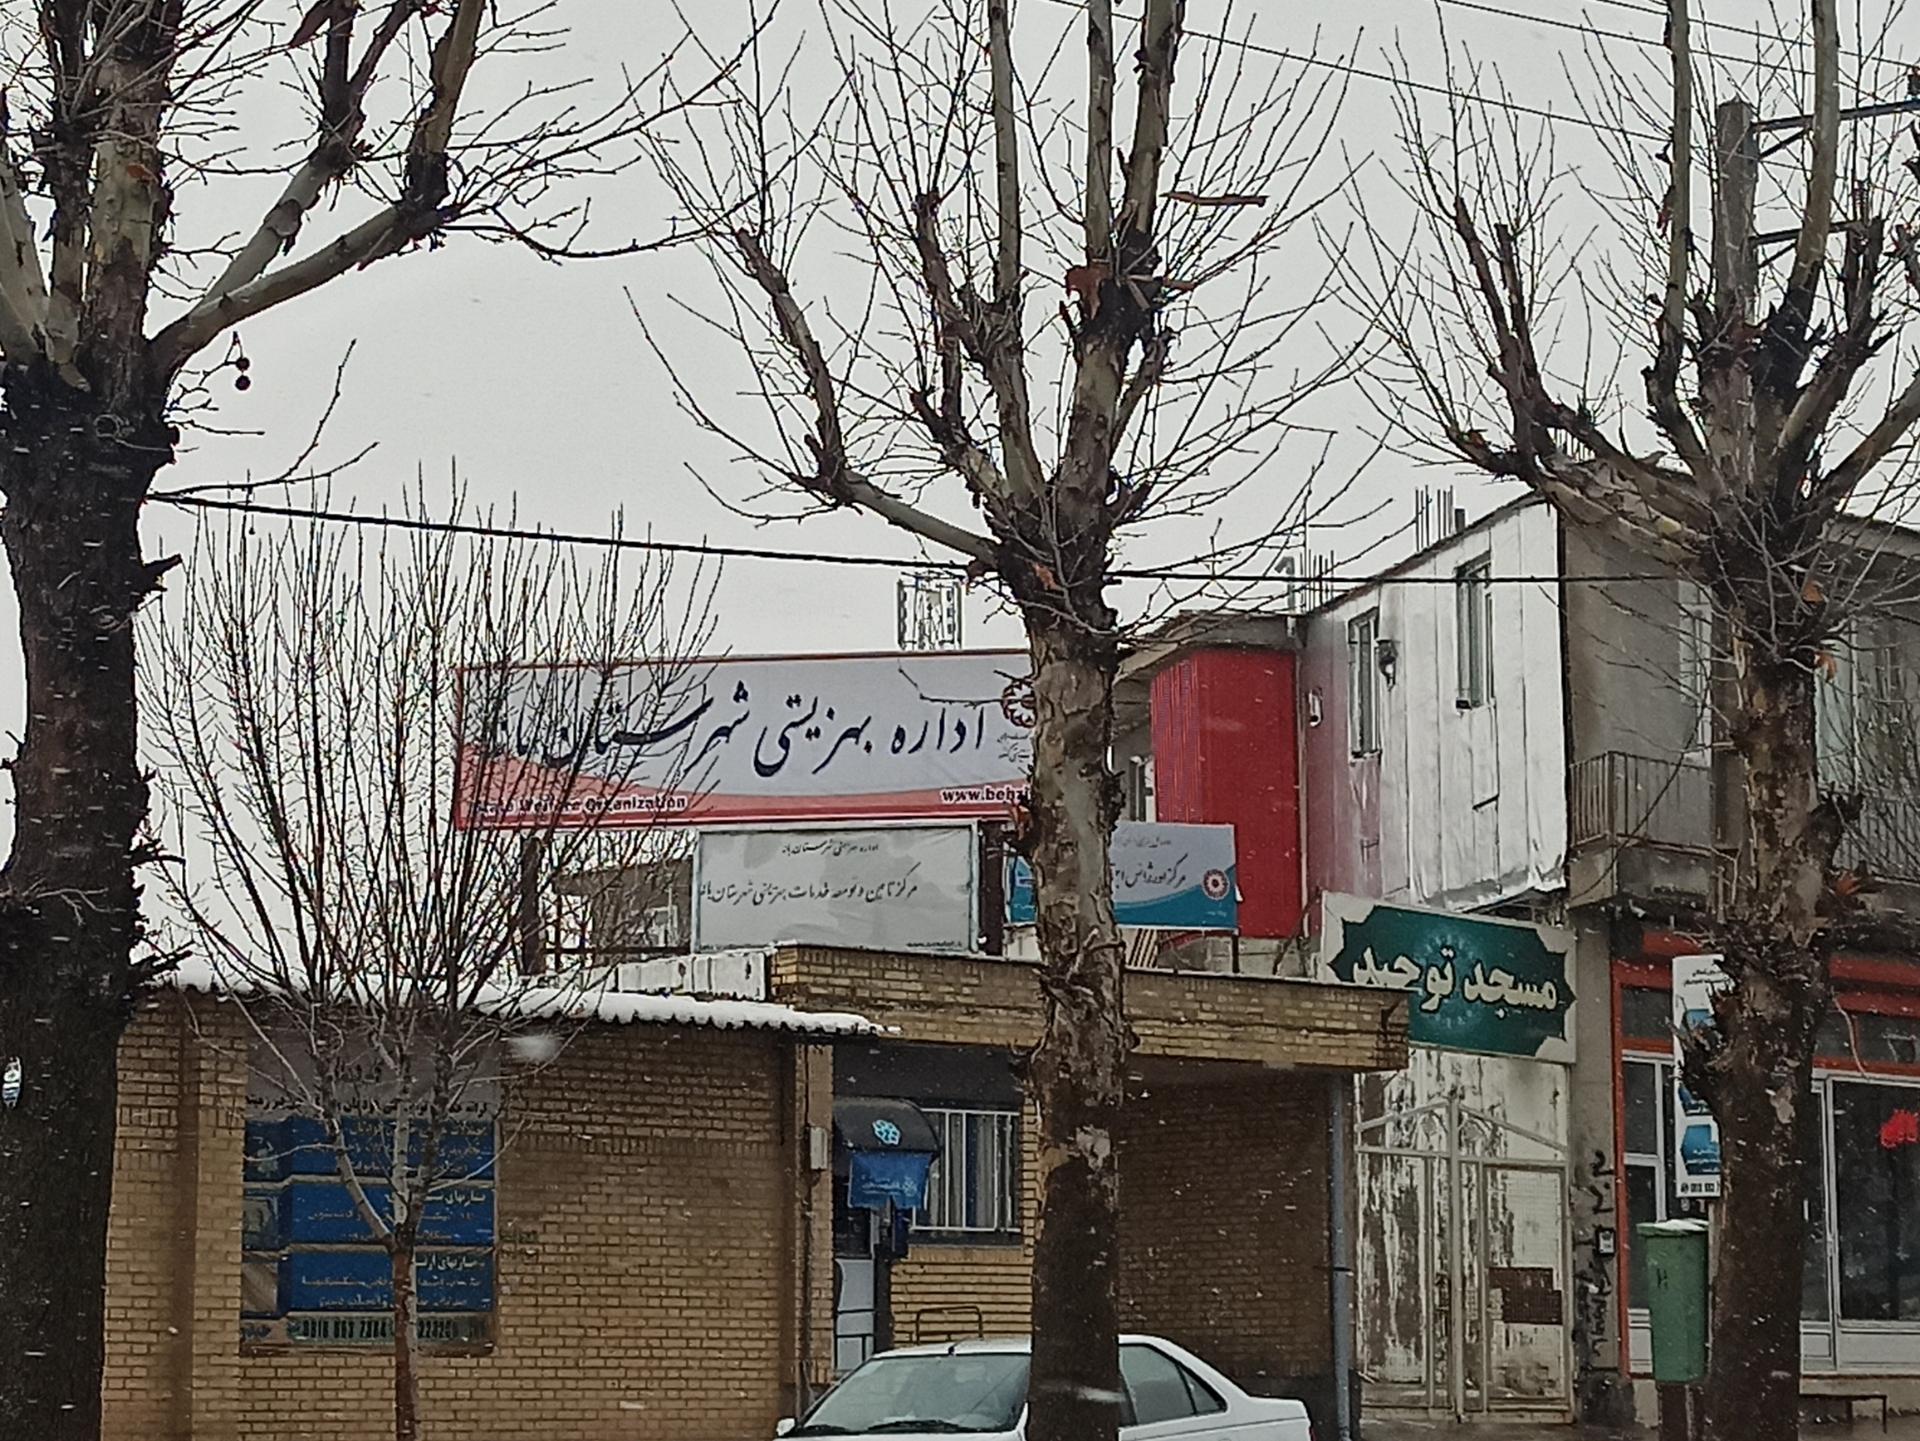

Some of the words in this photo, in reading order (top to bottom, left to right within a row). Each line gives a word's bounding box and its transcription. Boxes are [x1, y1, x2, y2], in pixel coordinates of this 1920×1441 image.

[543, 680, 750, 776] شهرستان
[754, 695, 872, 778] بهزیستی
[891, 706, 984, 754] اداره
[519, 797, 581, 813] Welfre
[896, 861, 921, 898] مرکز
[1166, 852, 1188, 889] مرکز
[712, 879, 754, 905] شهرستان
[753, 880, 787, 905] بهزیستی
[788, 881, 830, 899] خدمات
[1353, 946, 1454, 1011] توحید
[1463, 960, 1558, 1019] مسجد
